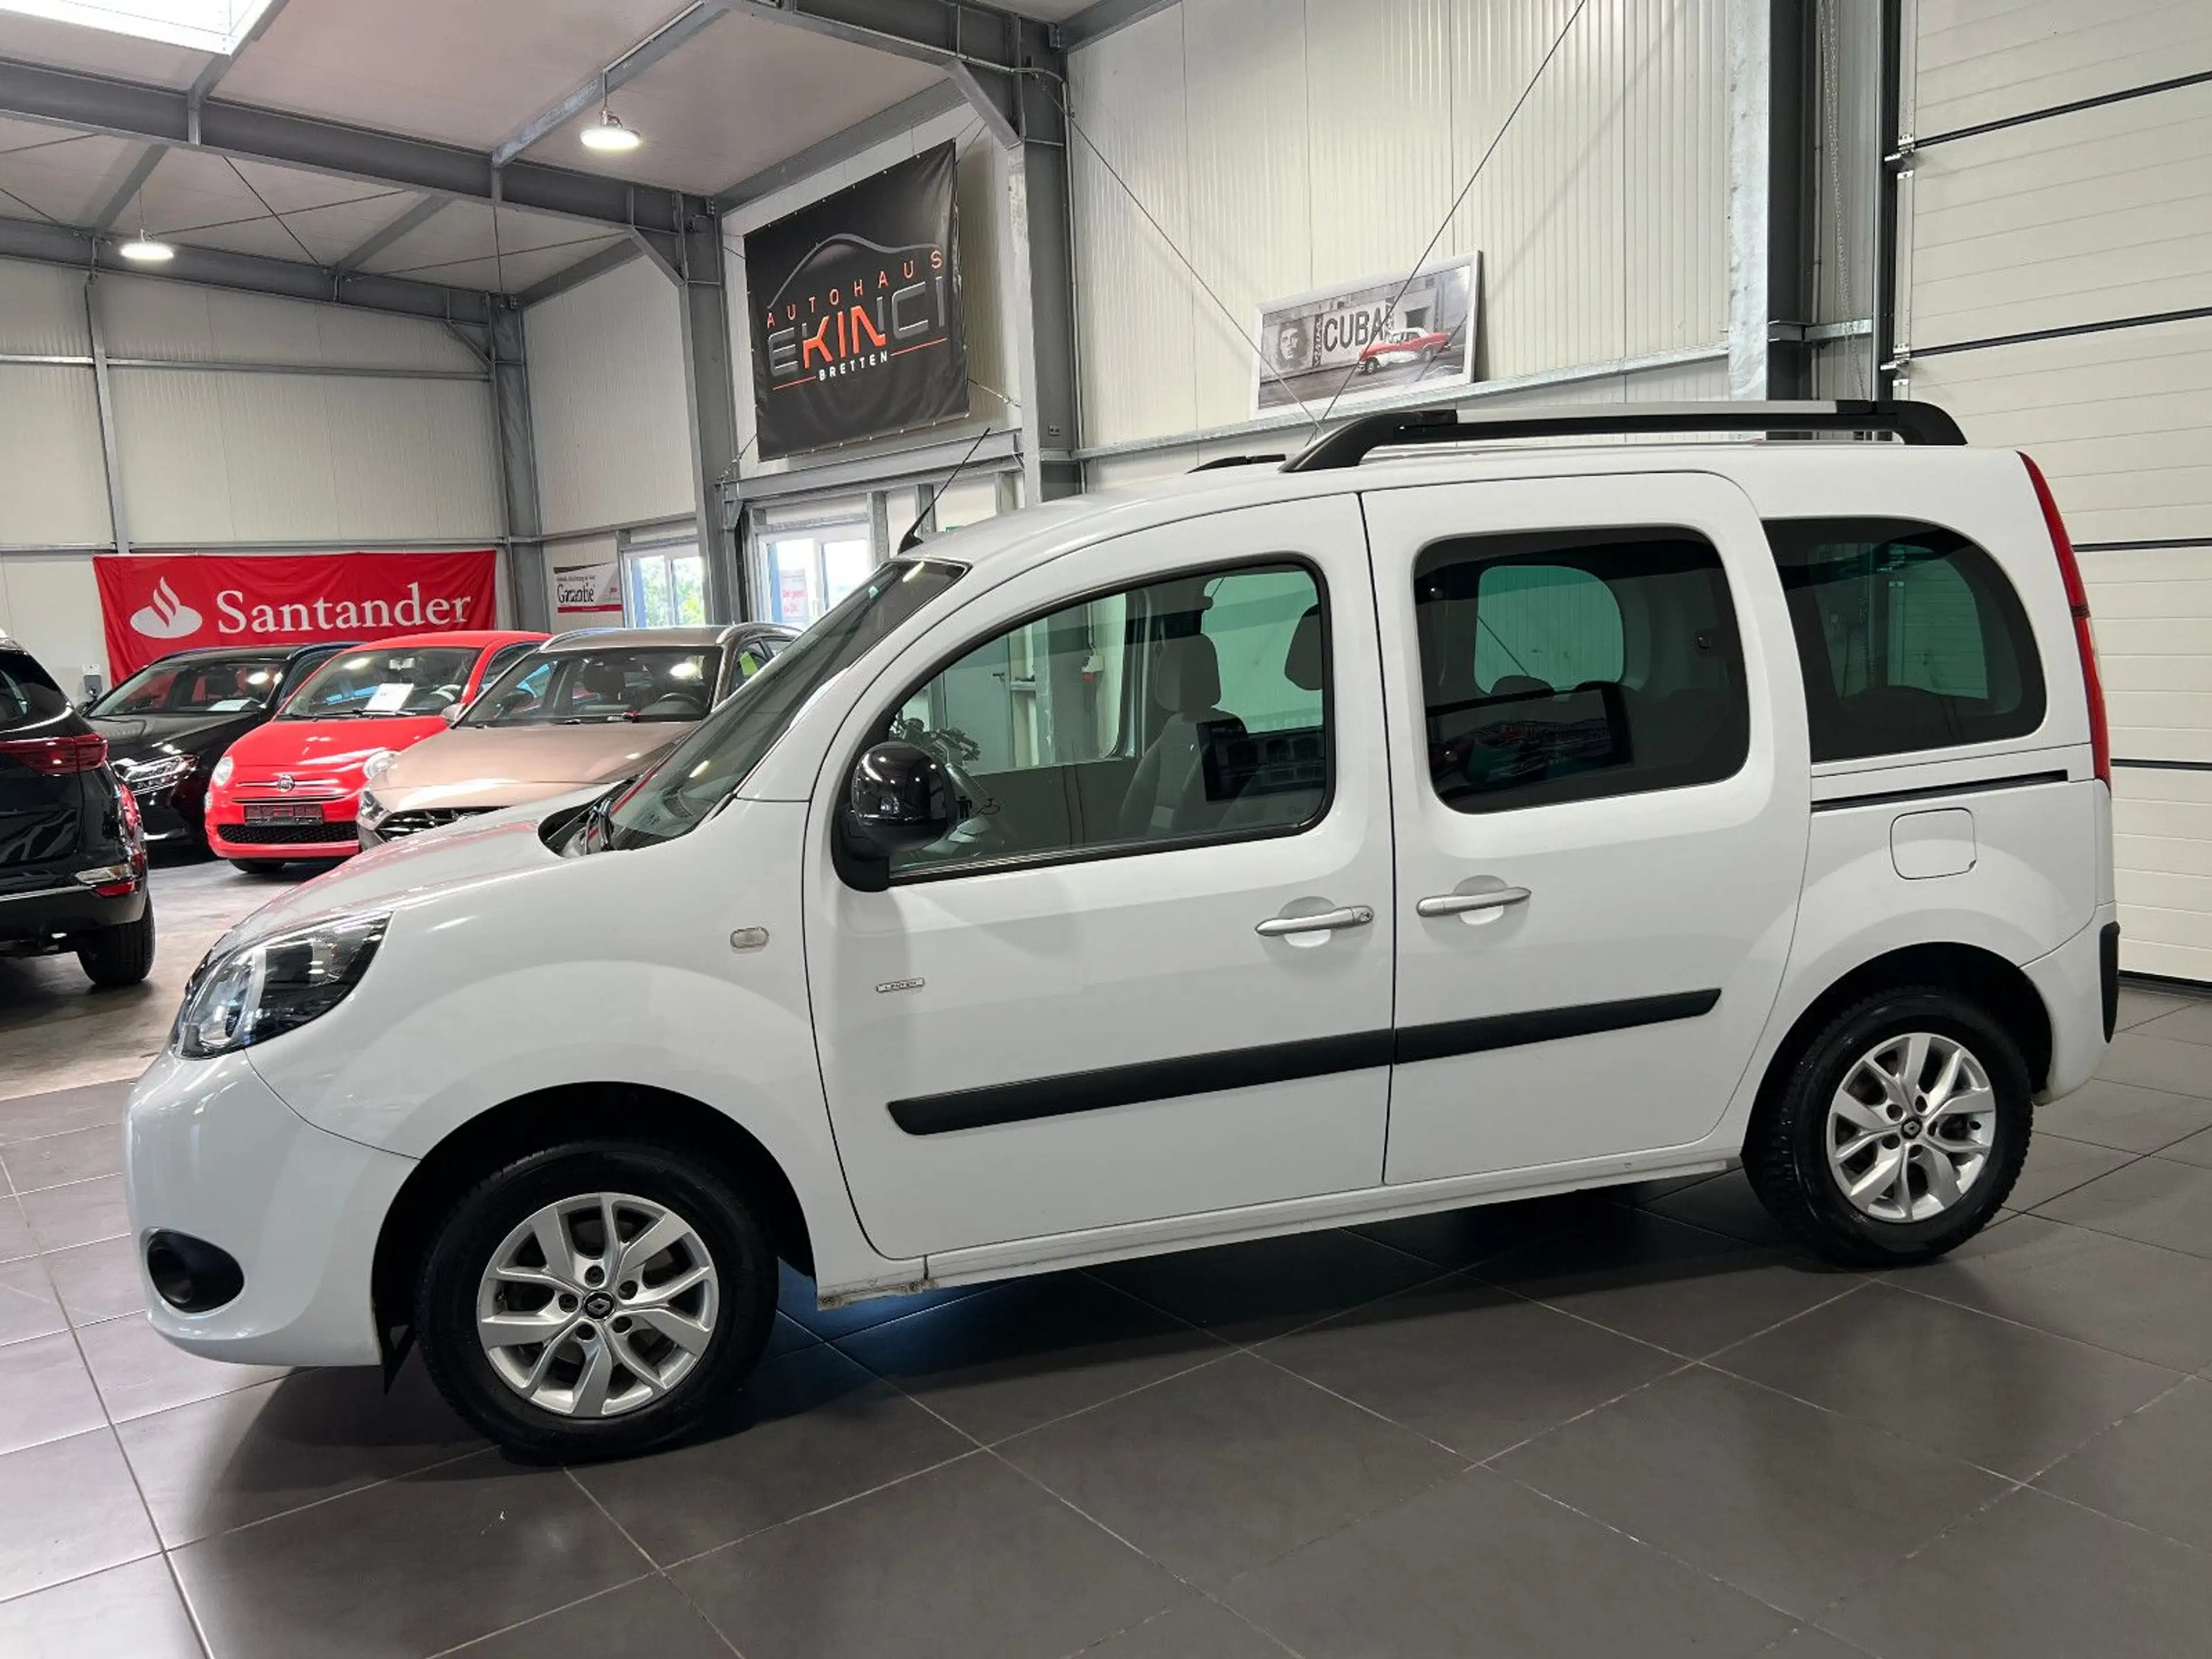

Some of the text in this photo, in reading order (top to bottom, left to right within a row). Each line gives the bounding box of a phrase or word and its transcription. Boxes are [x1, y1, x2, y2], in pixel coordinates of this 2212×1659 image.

[766, 250, 943, 328] AUTOHAUS
[768, 276, 945, 377] EKINCI
[1324, 308, 1385, 352] CUBA
[819, 351, 888, 381] BRETTEN
[216, 582, 472, 634] Santander
